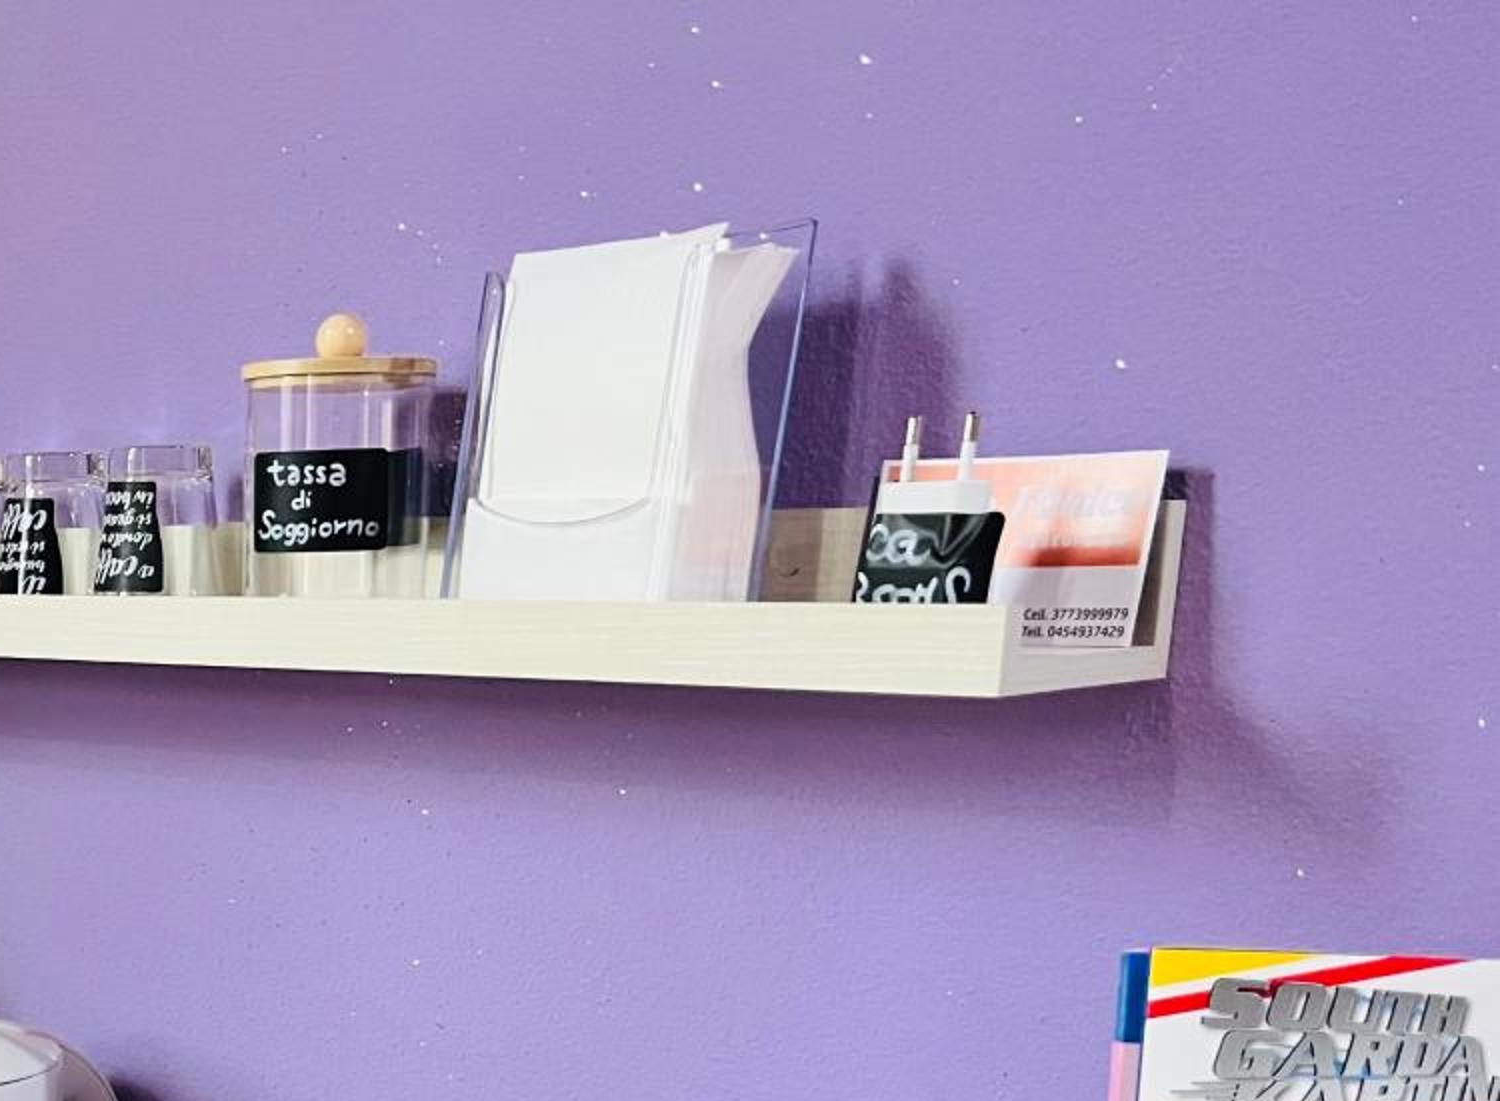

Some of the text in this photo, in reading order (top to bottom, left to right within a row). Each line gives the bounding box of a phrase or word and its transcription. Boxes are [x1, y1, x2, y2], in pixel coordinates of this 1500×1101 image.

[266, 459, 347, 487] tassa
[291, 489, 312, 511] di
[258, 509, 380, 546] Soggiorno
[1201, 977, 1472, 1033] SOUTH
[1212, 1029, 1488, 1080] GARDA
